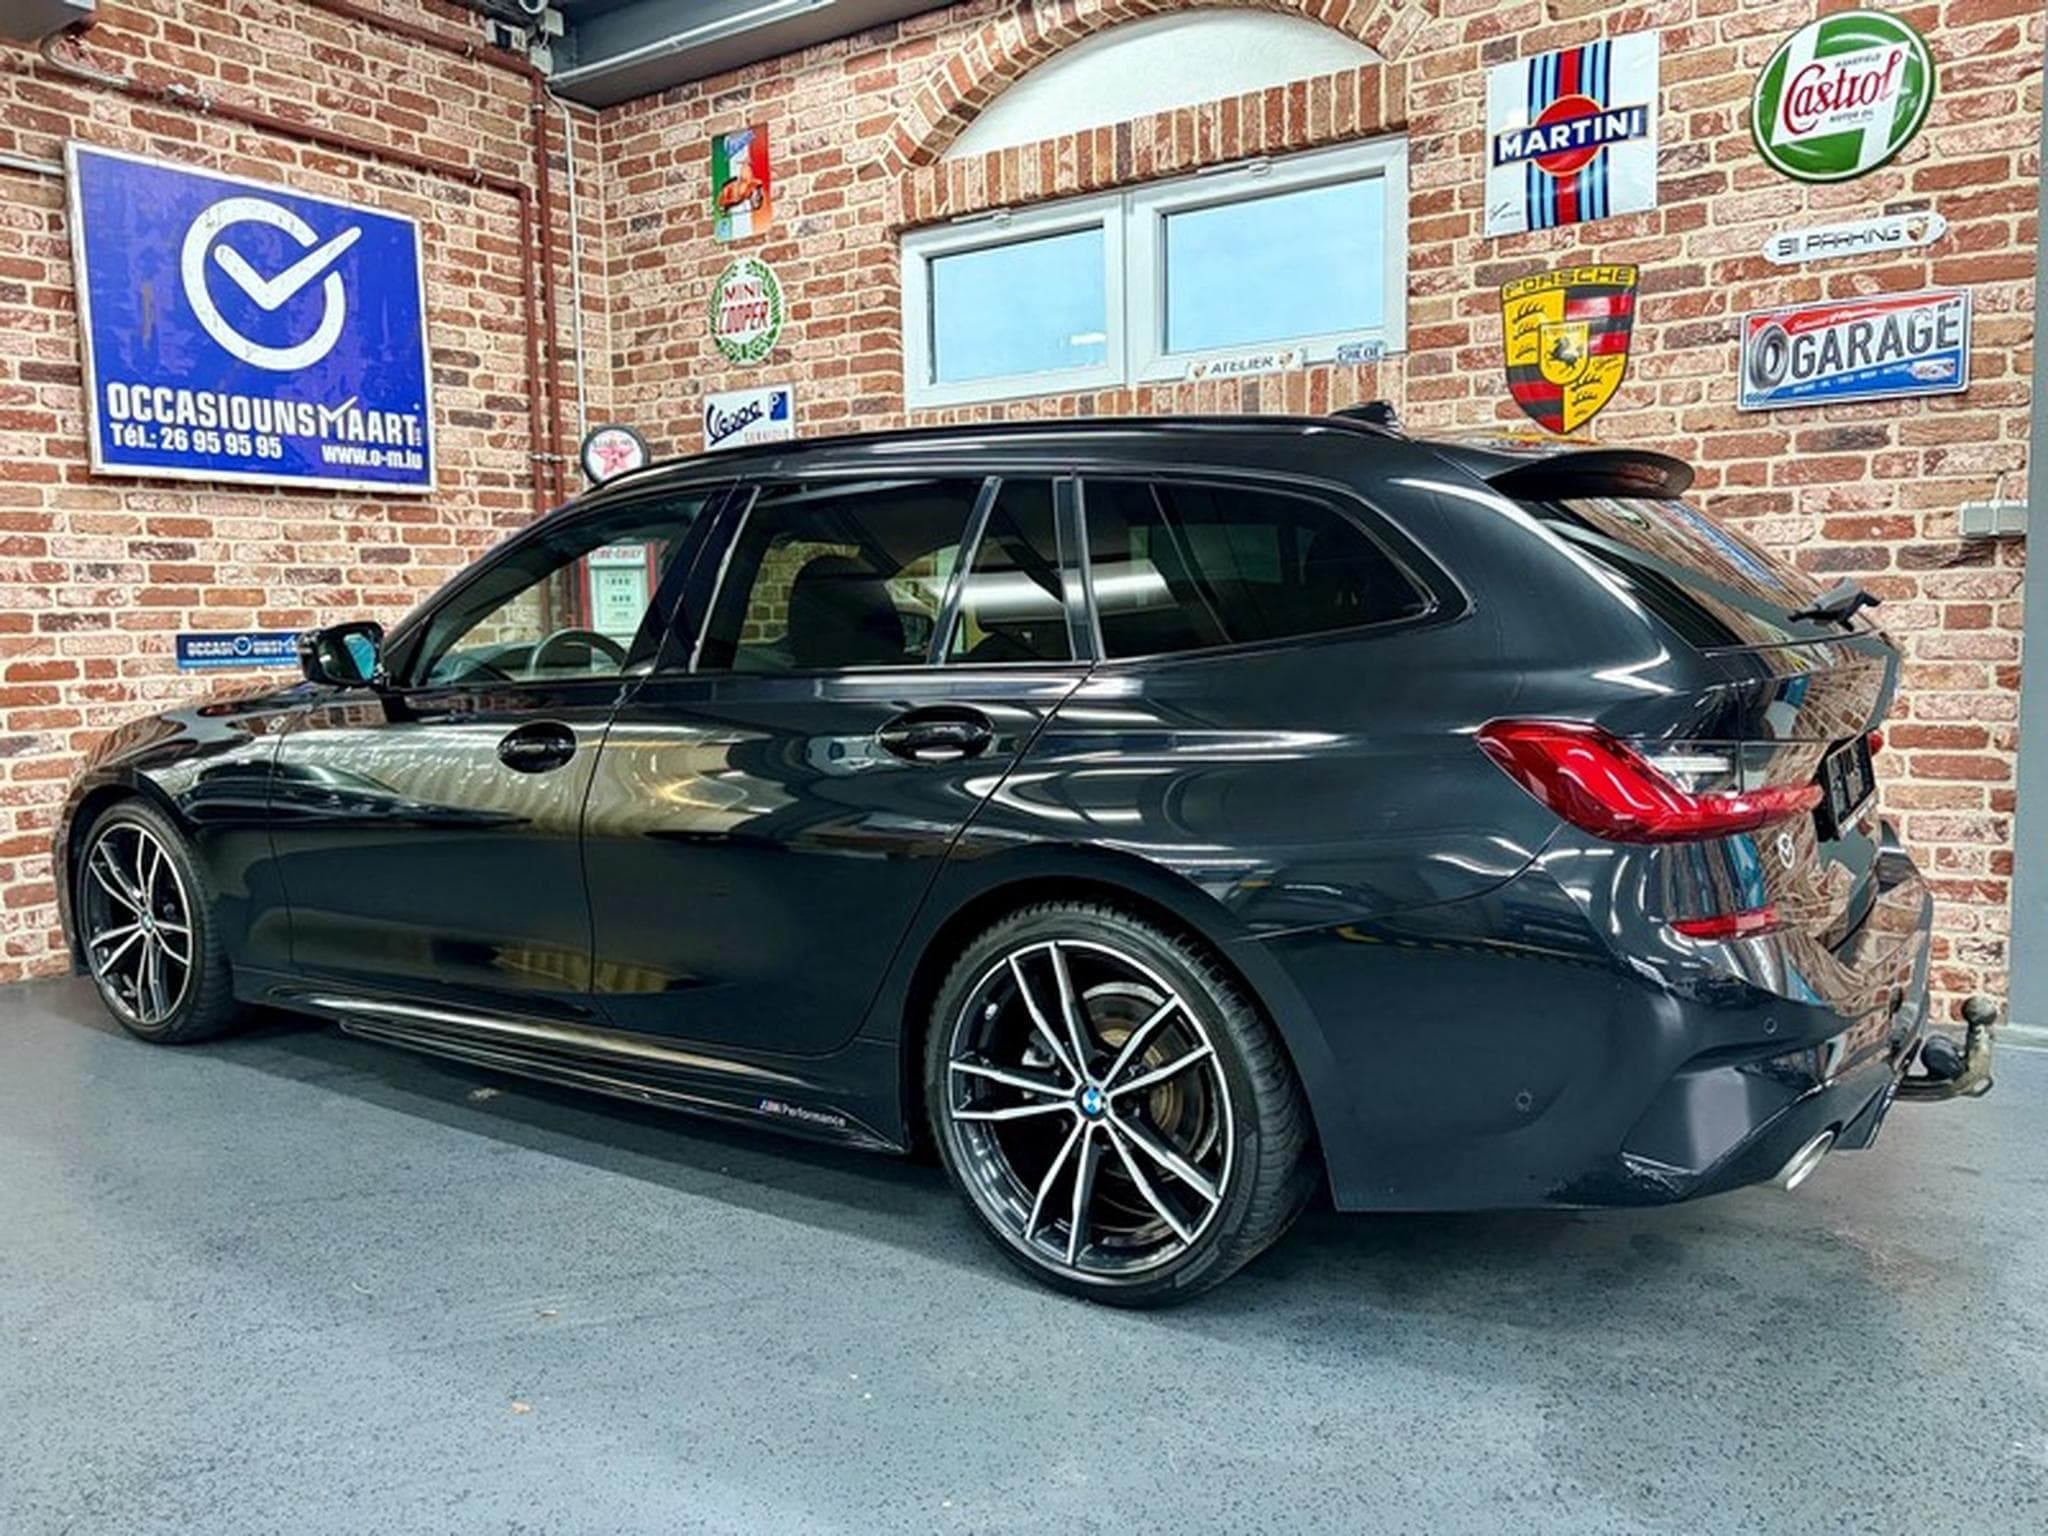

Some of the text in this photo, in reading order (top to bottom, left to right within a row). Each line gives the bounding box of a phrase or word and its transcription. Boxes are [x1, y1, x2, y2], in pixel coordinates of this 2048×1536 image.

[1783, 50, 1902, 135] Castrol
[1500, 109, 1640, 161] MARTINI
[1806, 224, 1900, 251] PARKING
[724, 281, 762, 303] MINI
[1505, 267, 1631, 297] PORSCHE
[719, 301, 768, 335] COOPER
[1210, 356, 1274, 374] ATELIER
[106, 383, 417, 446] OCCASIOUNSMAART
[706, 402, 765, 446] Vespa
[161, 427, 189, 451] 26
[193, 430, 221, 454] 95
[224, 434, 252, 457] 95
[256, 437, 283, 459] 95
[321, 445, 423, 470] www.o-m.lu
